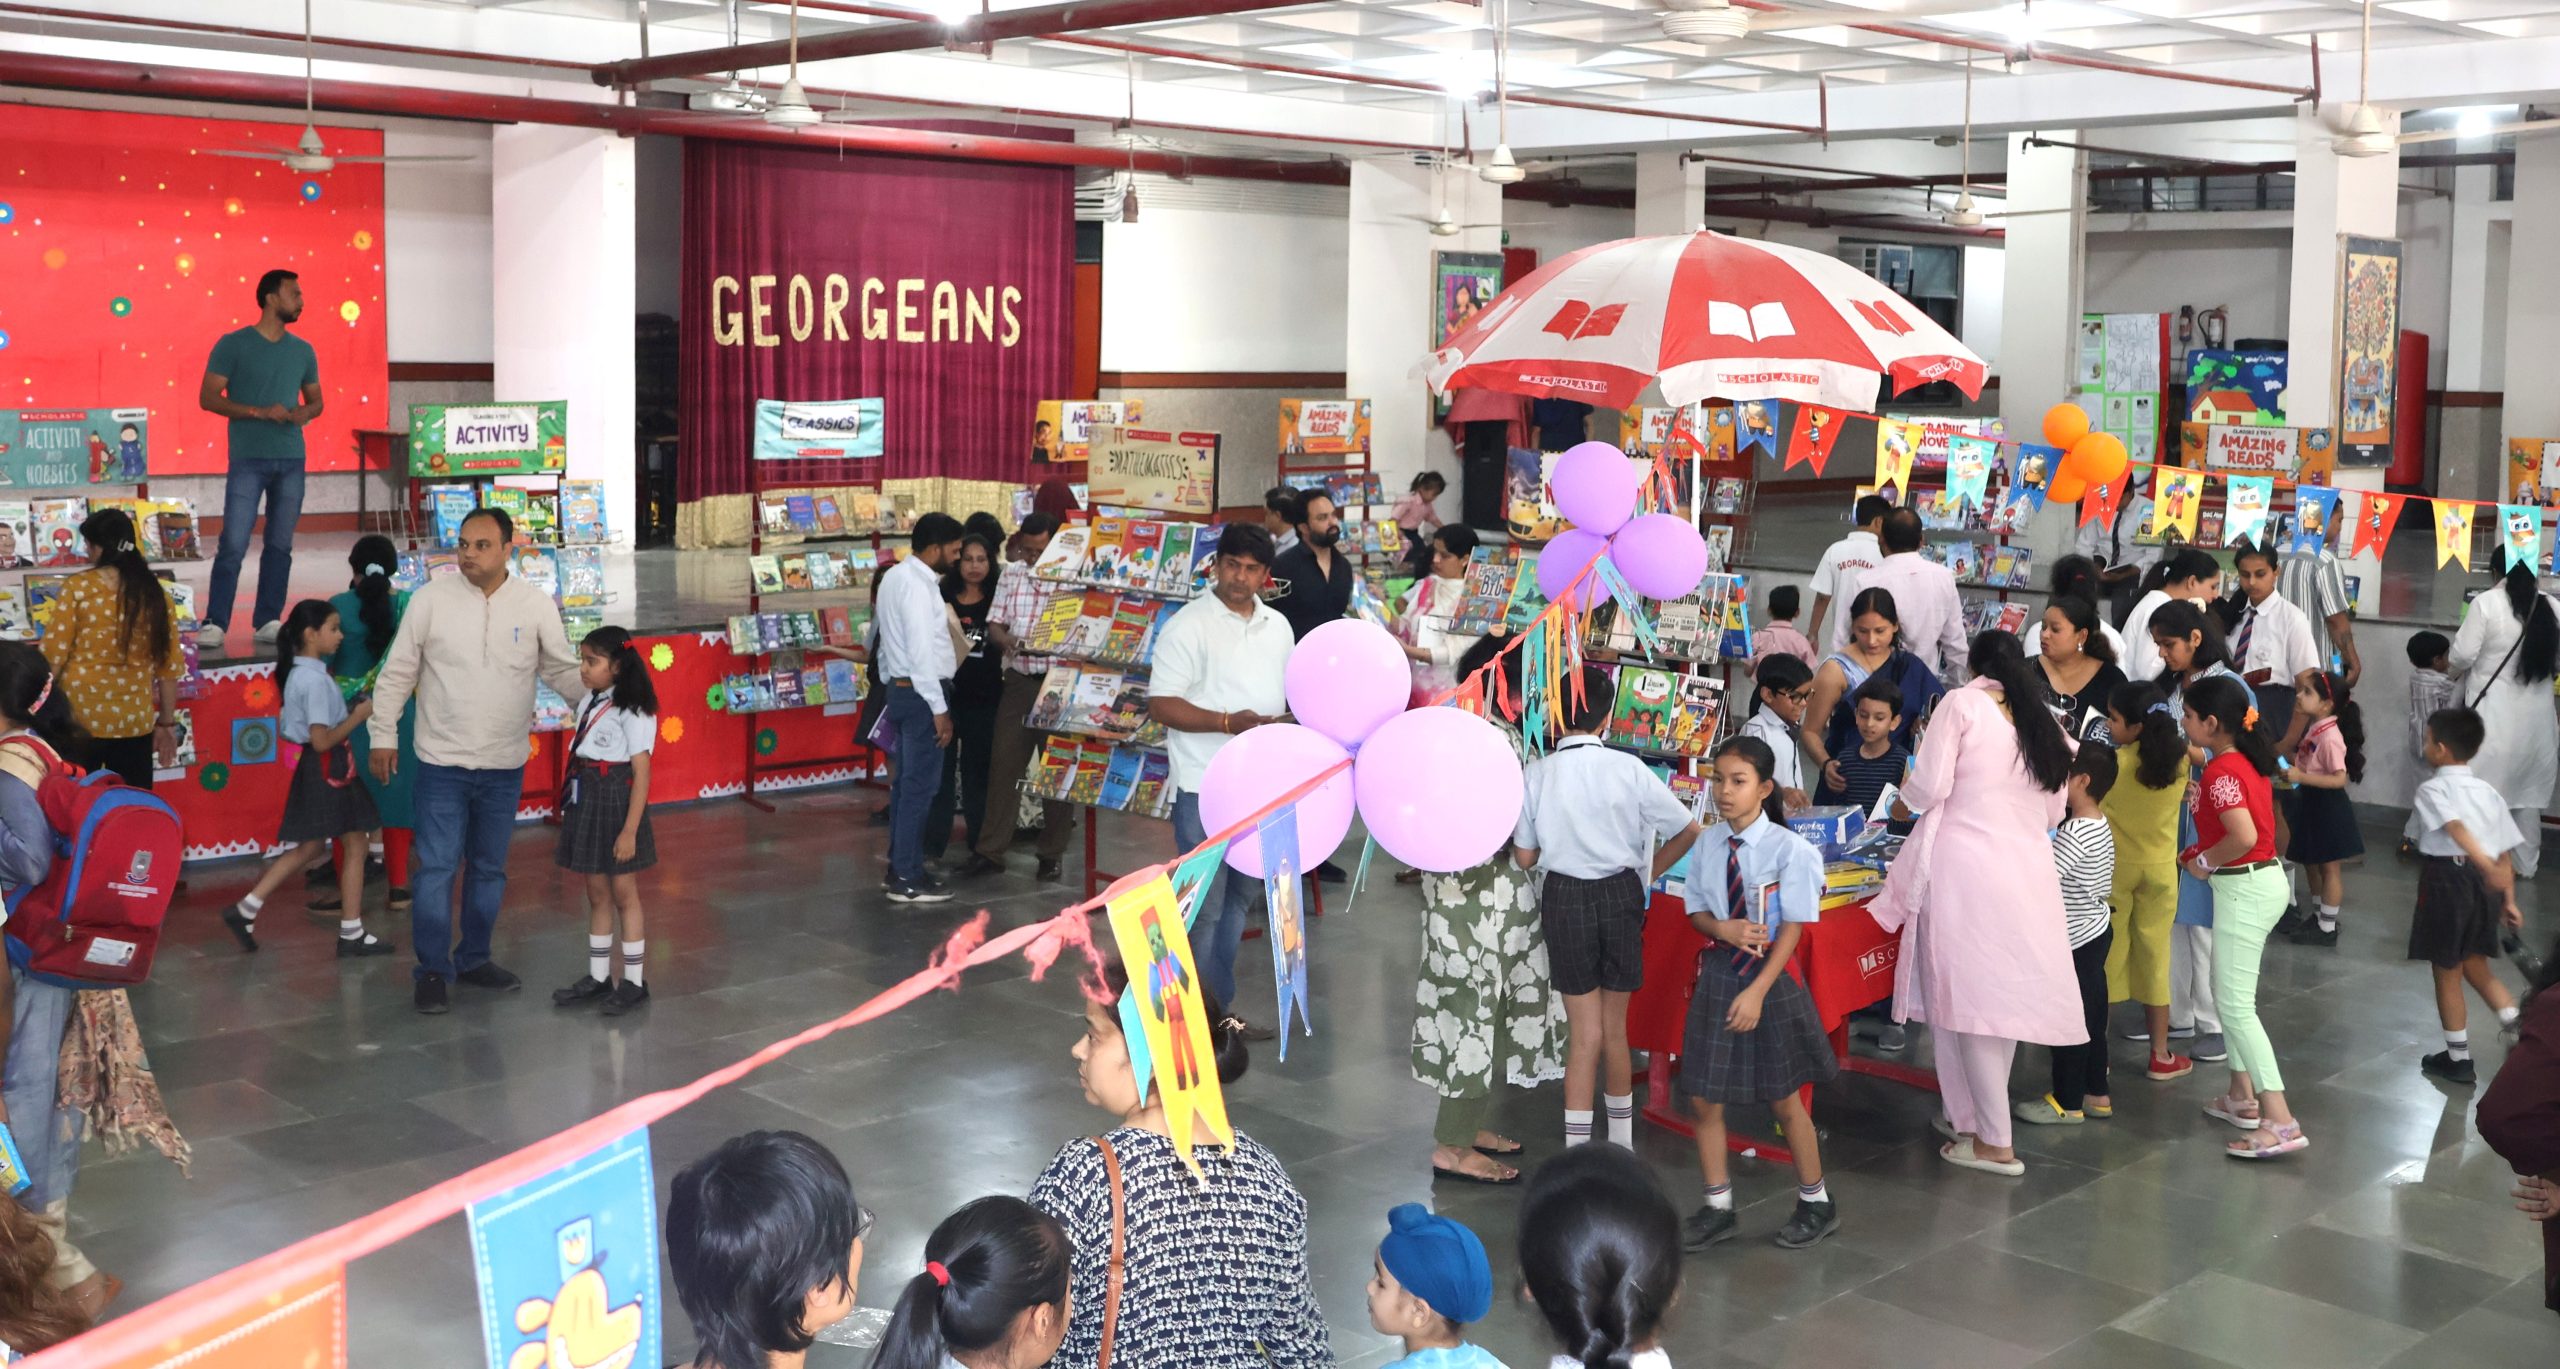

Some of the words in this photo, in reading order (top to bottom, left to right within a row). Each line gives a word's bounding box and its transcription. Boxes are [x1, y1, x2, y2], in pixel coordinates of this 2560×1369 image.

[712, 273, 1022, 347] GEORGEANS
[1534, 377, 1607, 392] SCHOLASTIC
[1729, 373, 1819, 385] SCHOLASTIC
[788, 416, 855, 431] CLASSICS
[1308, 409, 1348, 423] AMAZING
[456, 423, 529, 445] ACTIVITY
[1310, 420, 1340, 435] READS
[25, 427, 81, 449] ACTIVITY
[1920, 436, 1949, 448] NOVE
[2220, 433, 2287, 455] AMAZING
[1114, 450, 1184, 481] MATHEMATICS
[2227, 450, 2275, 468] READS
[26, 463, 77, 485] HOBBIES
[490, 491, 518, 502] BRAIN
[490, 499, 518, 507] GAMES
